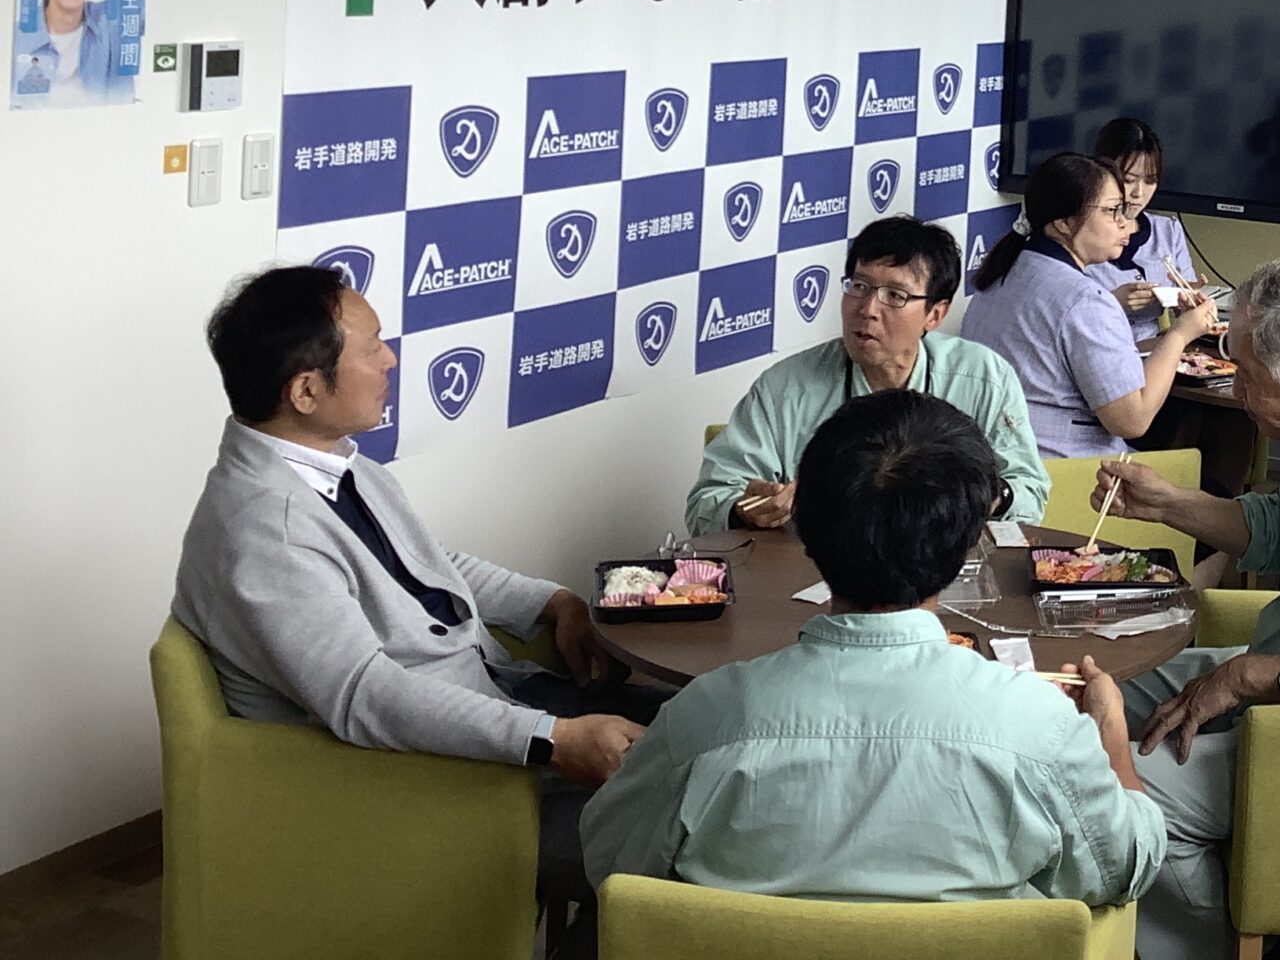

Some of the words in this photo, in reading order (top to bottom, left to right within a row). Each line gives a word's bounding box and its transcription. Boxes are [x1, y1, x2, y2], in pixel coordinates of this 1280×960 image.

[858, 79, 915, 117] ACE-PATCH
[979, 76, 1003, 91] 岩手道
[714, 99, 777, 121] 岩手道路開発
[529, 110, 618, 158] ACE-PATCH
[295, 139, 396, 170] 岩手道路開発
[919, 164, 964, 186] 岩手道路開発
[782, 182, 846, 223] ACE-PATCH
[626, 212, 693, 241] 岩手道路開発
[408, 244, 511, 296] ACE-PATCH
[699, 297, 771, 342] ACE-PATCH
[519, 340, 604, 375] 岩手道路開発
